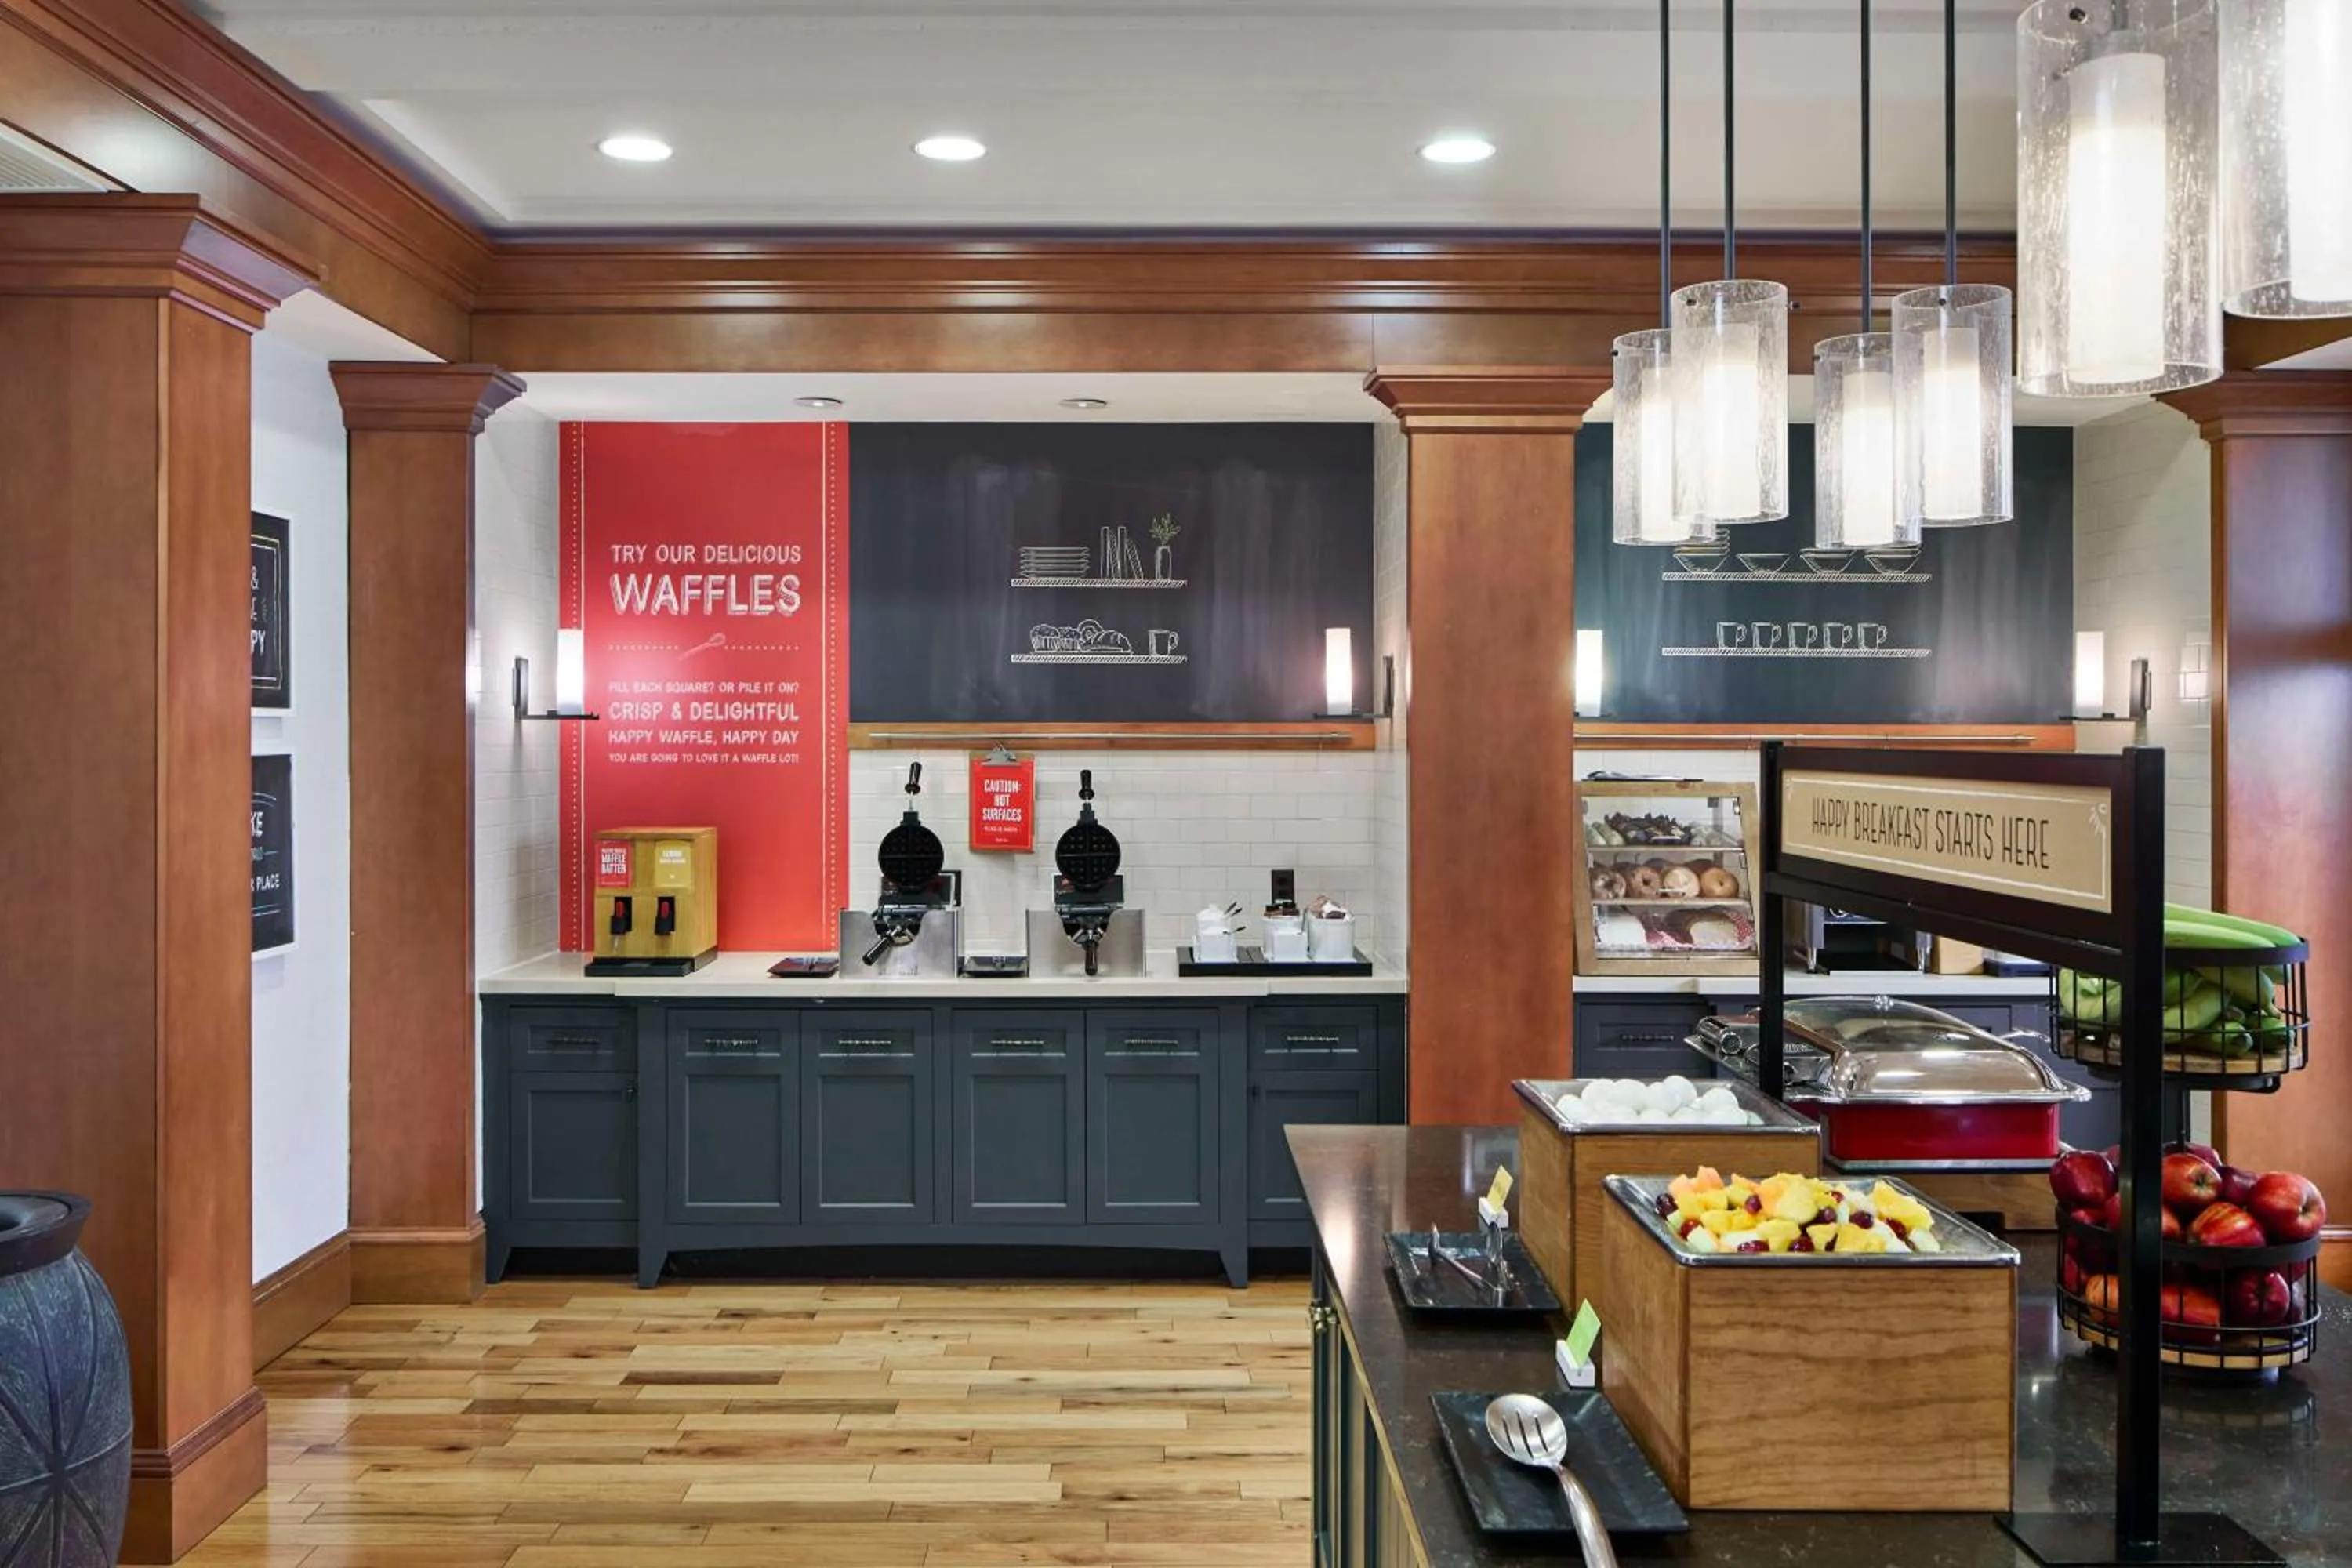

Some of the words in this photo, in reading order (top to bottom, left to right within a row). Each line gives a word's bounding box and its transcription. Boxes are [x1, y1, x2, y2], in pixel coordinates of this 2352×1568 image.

[611, 544, 648, 564] TRY
[655, 544, 696, 564] OUR
[703, 544, 802, 564] DELICIOUS
[609, 573, 801, 617] WAFFLES
[608, 681, 630, 694] FILL
[633, 681, 662, 694] EACH
[666, 681, 715, 694] SQUARE?
[718, 681, 735, 694] OR
[738, 681, 761, 694] PILE
[764, 681, 774, 694] IT
[778, 681, 800, 694] ON?
[608, 702, 663, 721] CRISP
[670, 702, 682, 721] &
[689, 702, 800, 721] DELIGHTFUL
[608, 730, 653, 745] HAPPY
[659, 730, 718, 746] WAFFLE,
[722, 730, 768, 745] HAPPY
[772, 730, 800, 745] DAY
[608, 753, 627, 764] YOU
[630, 753, 649, 764] ARE
[650, 753, 678, 764] GOING
[682, 753, 694, 764] TO
[696, 753, 719, 764] LOVE
[720, 753, 729, 764] IT
[731, 753, 739, 764] A
[742, 753, 777, 764] WAFFLE
[779, 753, 800, 764] LOT!
[994, 793, 1011, 807] HOT
[982, 808, 1022, 822] SURFACES
[1811, 797, 1850, 839] HAPPY
[1853, 801, 1932, 853] BREAKFAST
[1935, 809, 1994, 862] STARTS
[2001, 815, 2050, 870] HERE
[601, 863, 626, 874] BATTER
[256, 873, 281, 891] PLACE
